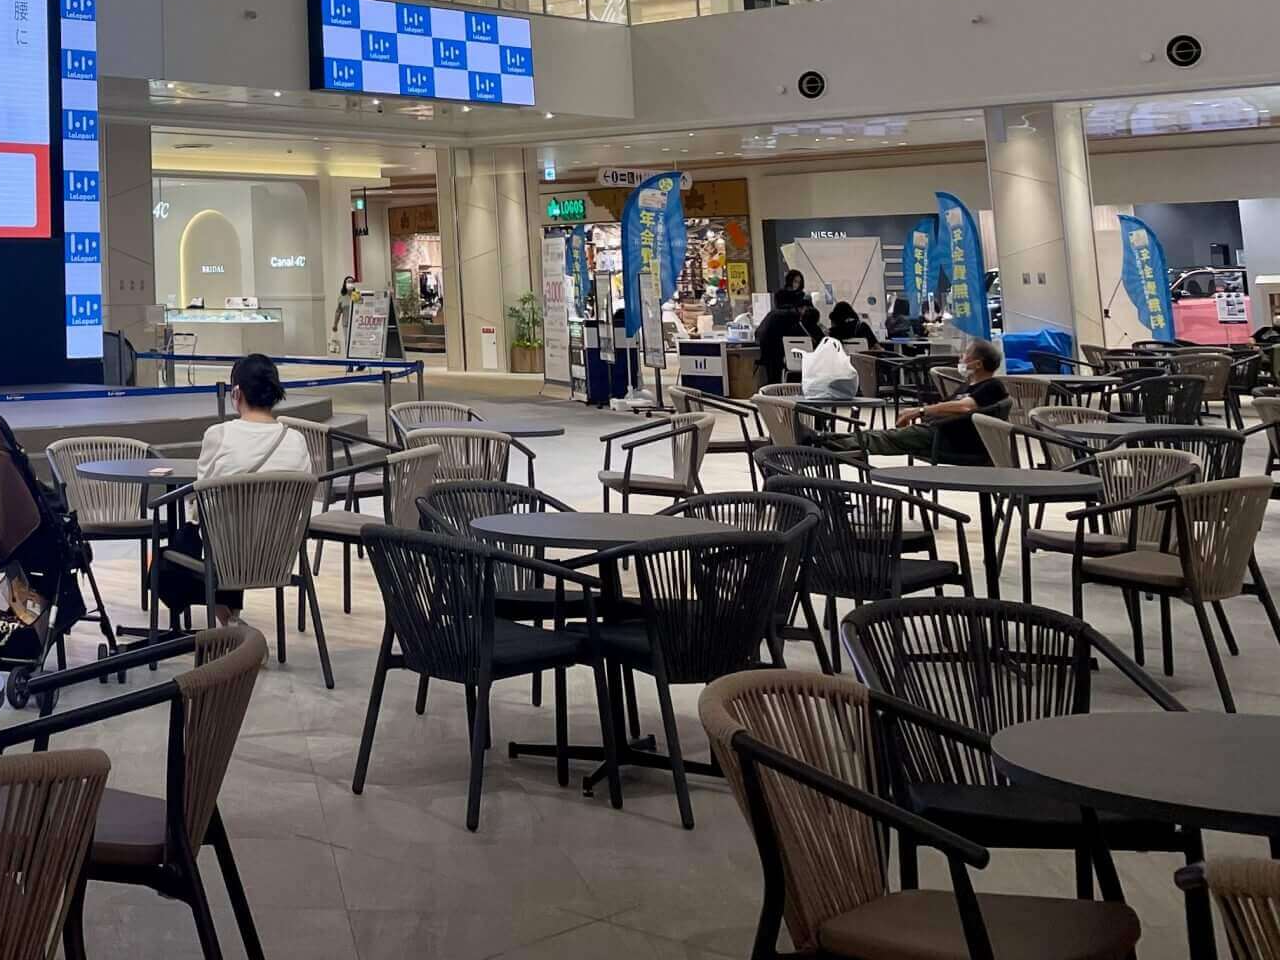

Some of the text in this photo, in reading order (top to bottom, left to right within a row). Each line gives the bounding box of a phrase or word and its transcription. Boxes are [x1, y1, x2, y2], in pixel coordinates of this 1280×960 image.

[560, 200, 584, 215] LOGOS
[810, 231, 848, 239] NISSAN
[201, 265, 225, 273] BRIDAL
